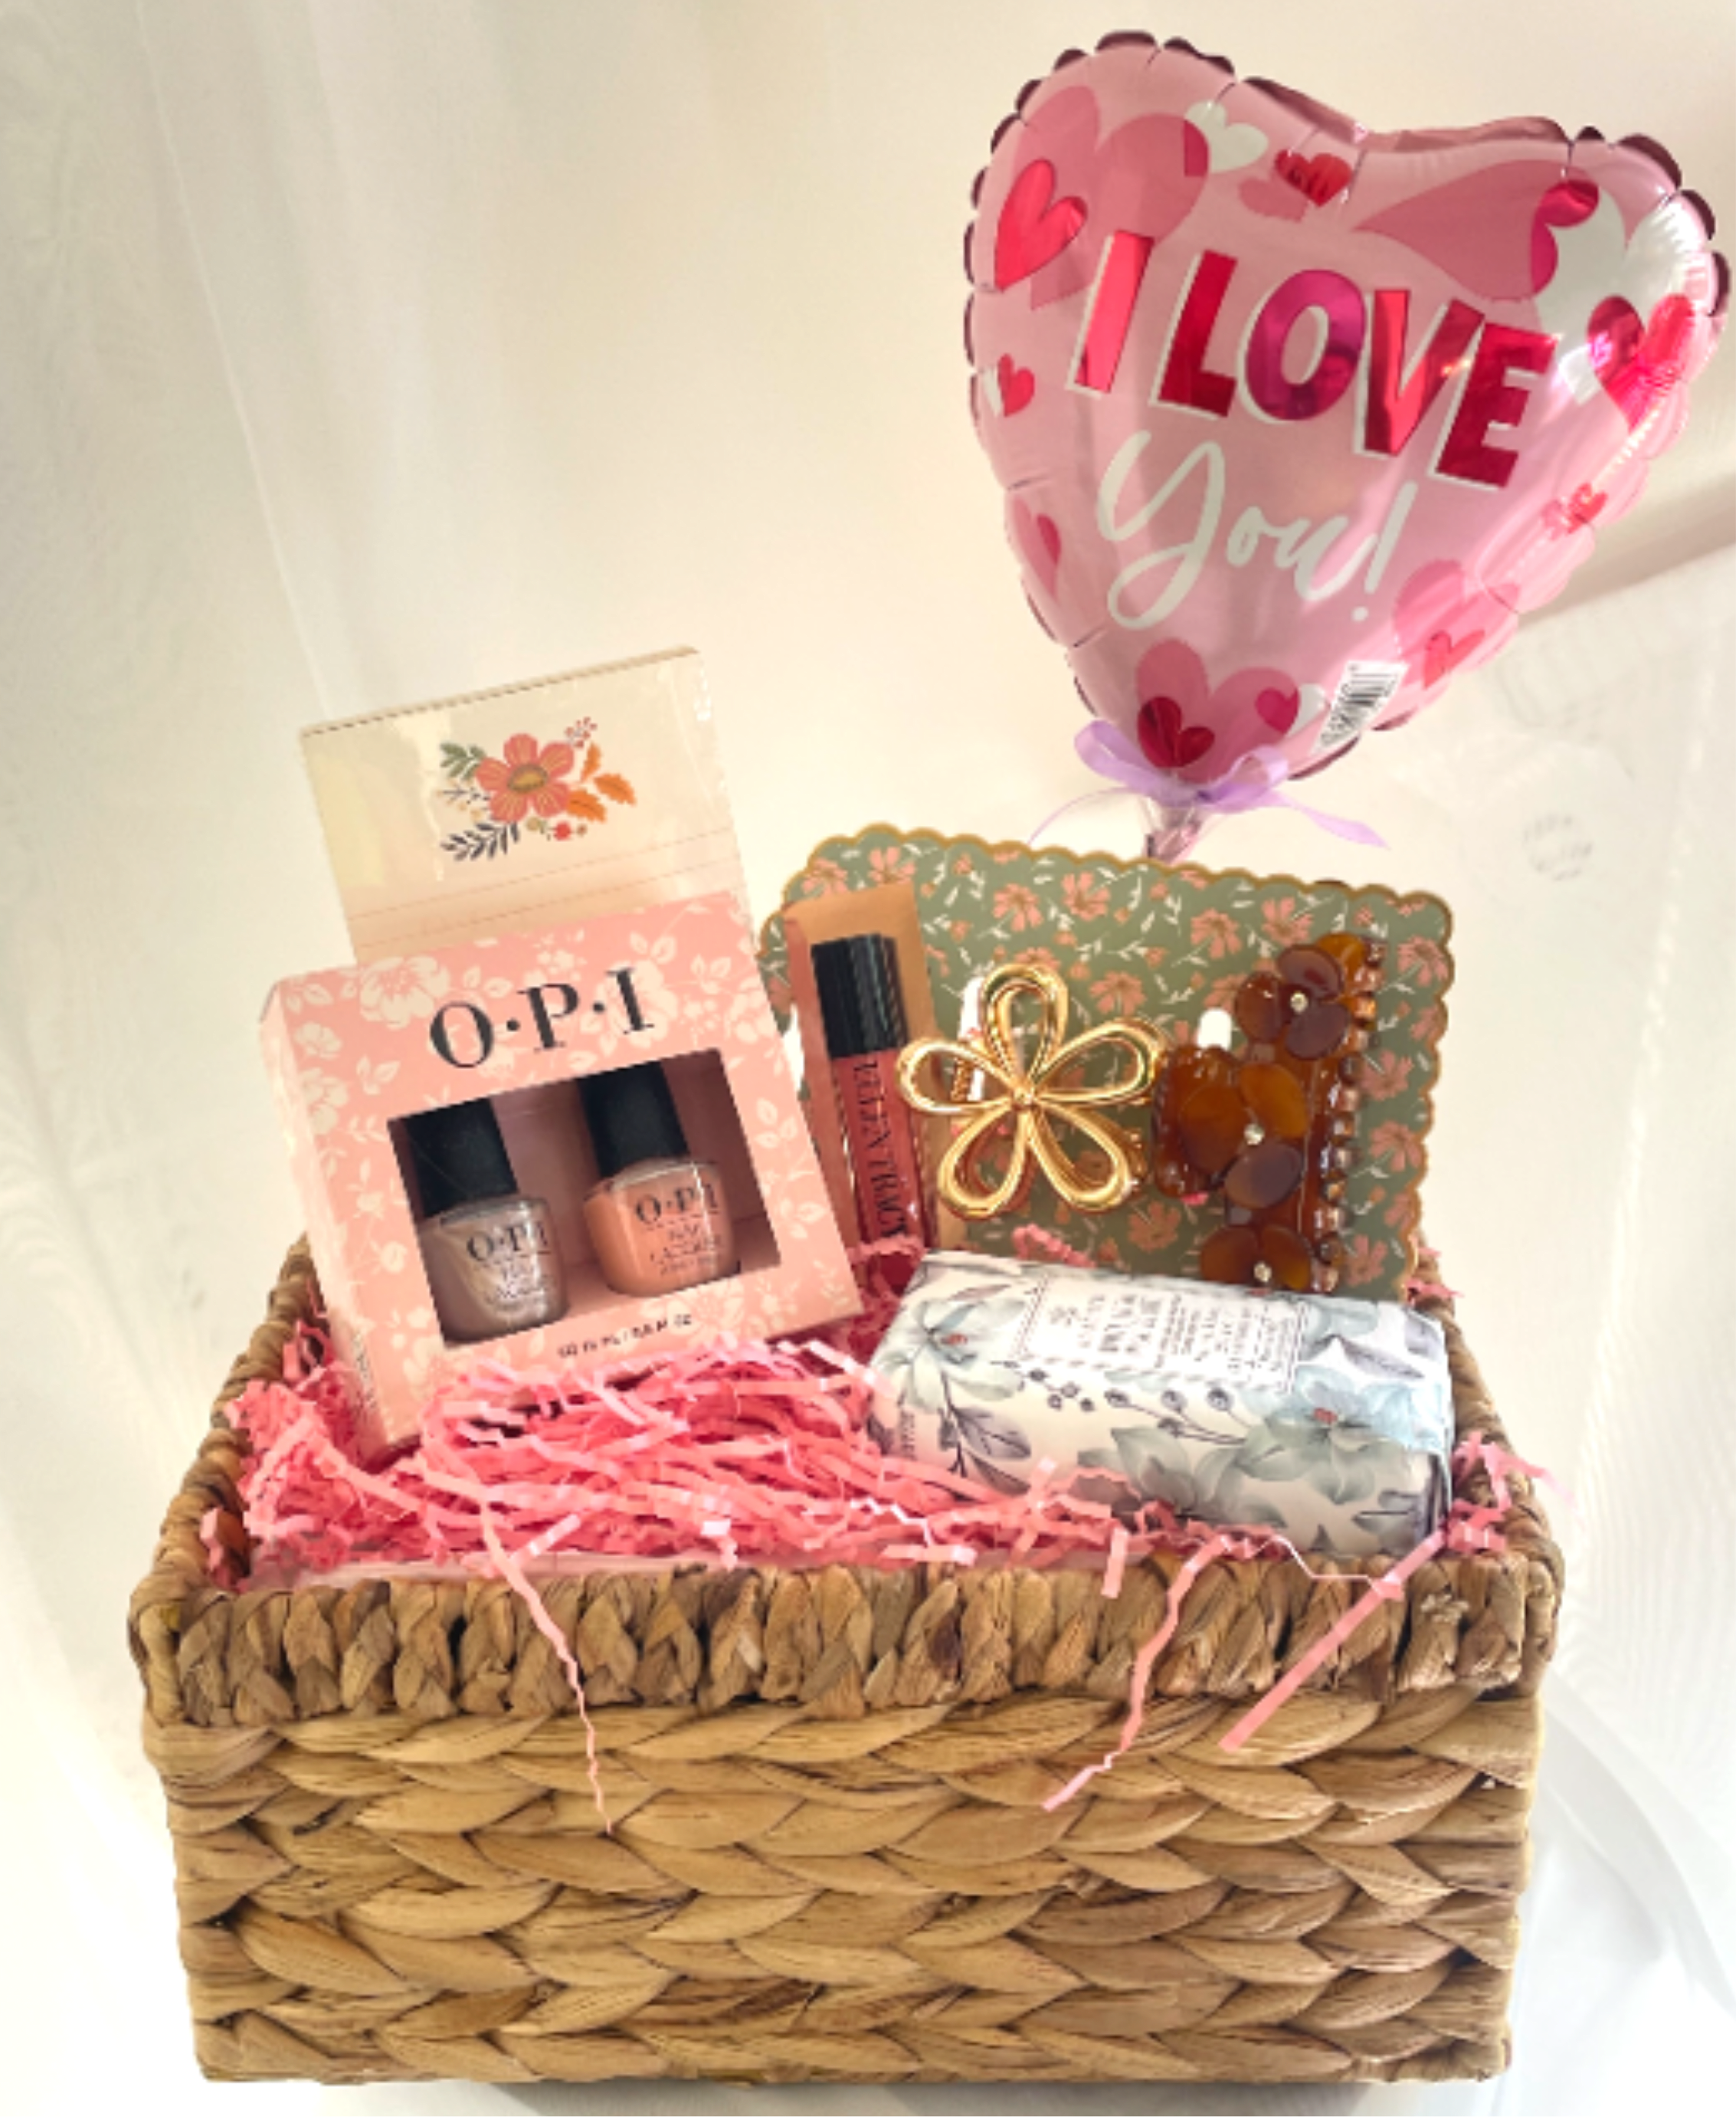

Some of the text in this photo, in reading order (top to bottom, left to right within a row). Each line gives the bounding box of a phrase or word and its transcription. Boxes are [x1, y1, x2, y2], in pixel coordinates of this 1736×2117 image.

[1067, 229, 1557, 490] I LOVE
[1097, 430, 1417, 630] You!
